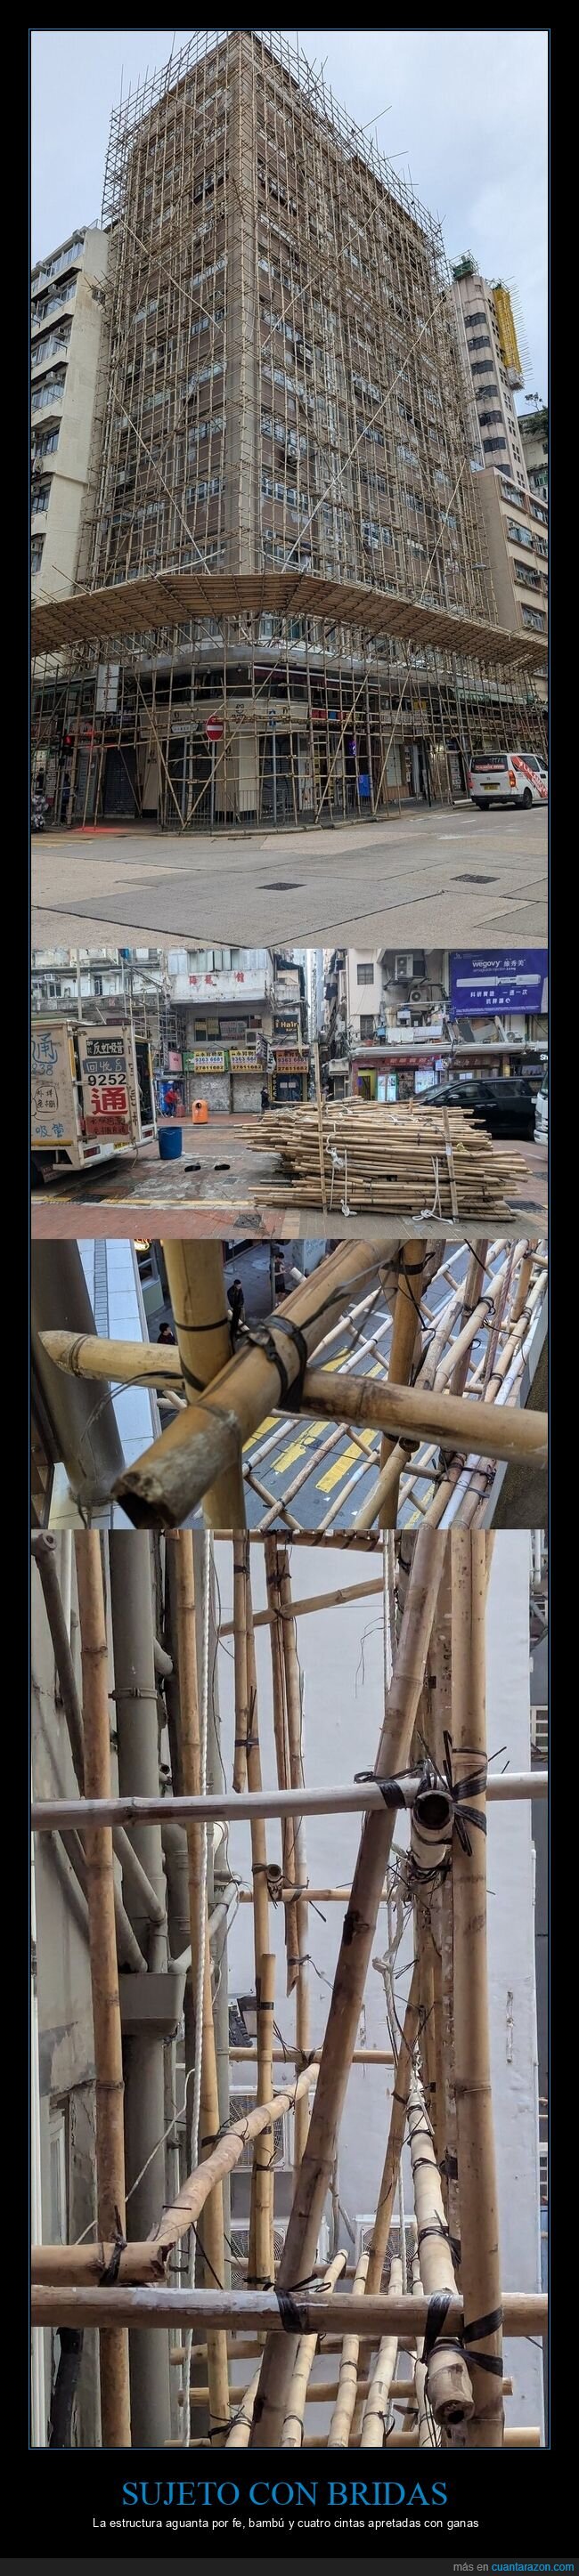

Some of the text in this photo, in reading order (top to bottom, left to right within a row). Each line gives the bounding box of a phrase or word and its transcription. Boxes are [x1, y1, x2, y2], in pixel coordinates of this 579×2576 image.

[472, 960, 501, 968] wegovy
[86, 1060, 113, 1073] 回收
[87, 1073, 126, 1087] 9252
[91, 1087, 128, 1115] 通
